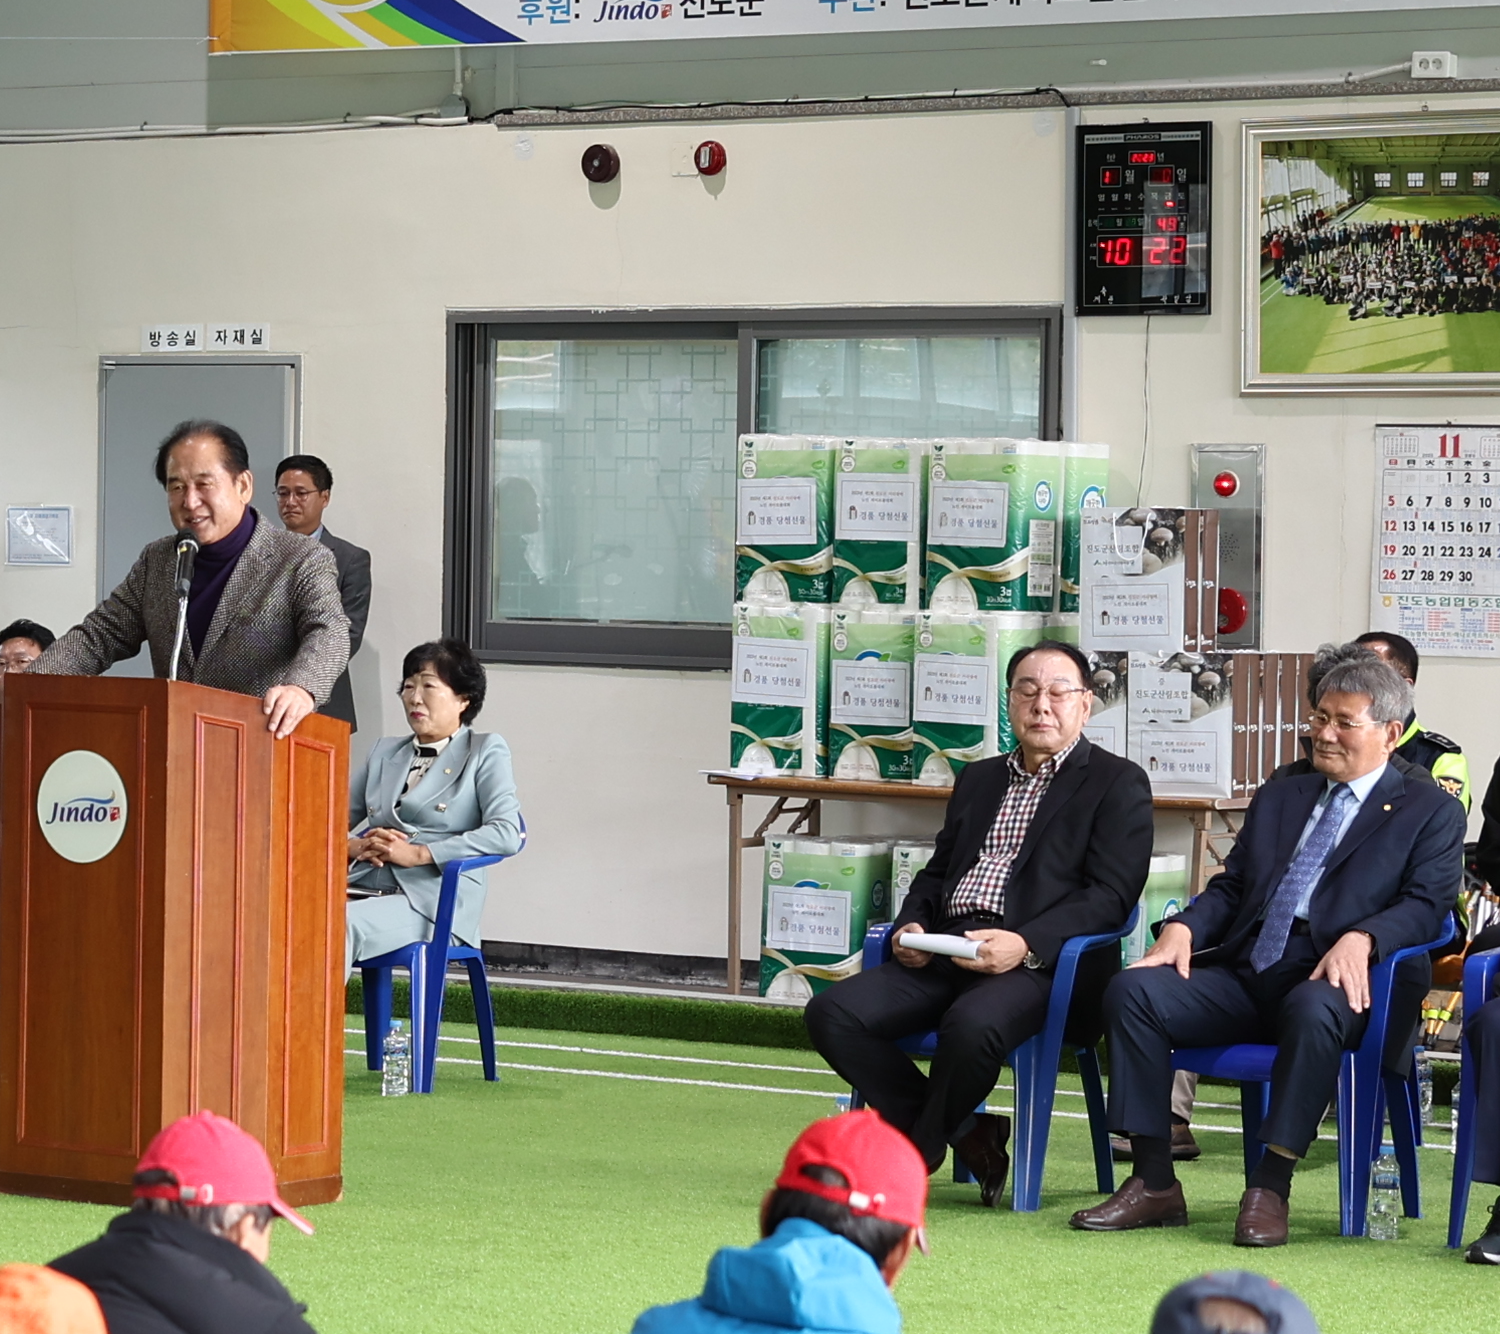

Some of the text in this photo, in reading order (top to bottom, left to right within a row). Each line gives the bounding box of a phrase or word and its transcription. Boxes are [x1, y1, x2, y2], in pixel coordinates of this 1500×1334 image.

[1149, 237, 1186, 263] 22
[148, 330, 197, 347] 방송실
[215, 328, 263, 345] 자재실
[1438, 433, 1460, 458] 11
[1446, 471, 1453, 483] 1
[1463, 472, 1472, 484] 2
[1482, 472, 1491, 484] 3
[1387, 495, 1396, 507] 5
[1406, 496, 1414, 507] 6
[1424, 496, 1433, 507] 7
[1444, 497, 1452, 508] 8
[1463, 497, 1472, 509] 9
[1479, 497, 1492, 509] 10
[1384, 520, 1398, 531] 12
[1402, 521, 1416, 533] 13
[1421, 521, 1436, 533] 14
[1440, 521, 1454, 533] 15
[1460, 521, 1474, 533] 16
[1478, 521, 1492, 534] 17
[1383, 545, 1396, 556] 19
[1402, 545, 1416, 557] 20
[1422, 545, 1435, 557] 21
[1440, 545, 1455, 557] 22
[1458, 546, 1474, 558] 23
[1478, 546, 1492, 559] 24
[1382, 569, 1473, 583] 26 27 28 29 30
[1135, 690, 1189, 699] 진도군산림조합
[46, 801, 107, 825] Jindo
